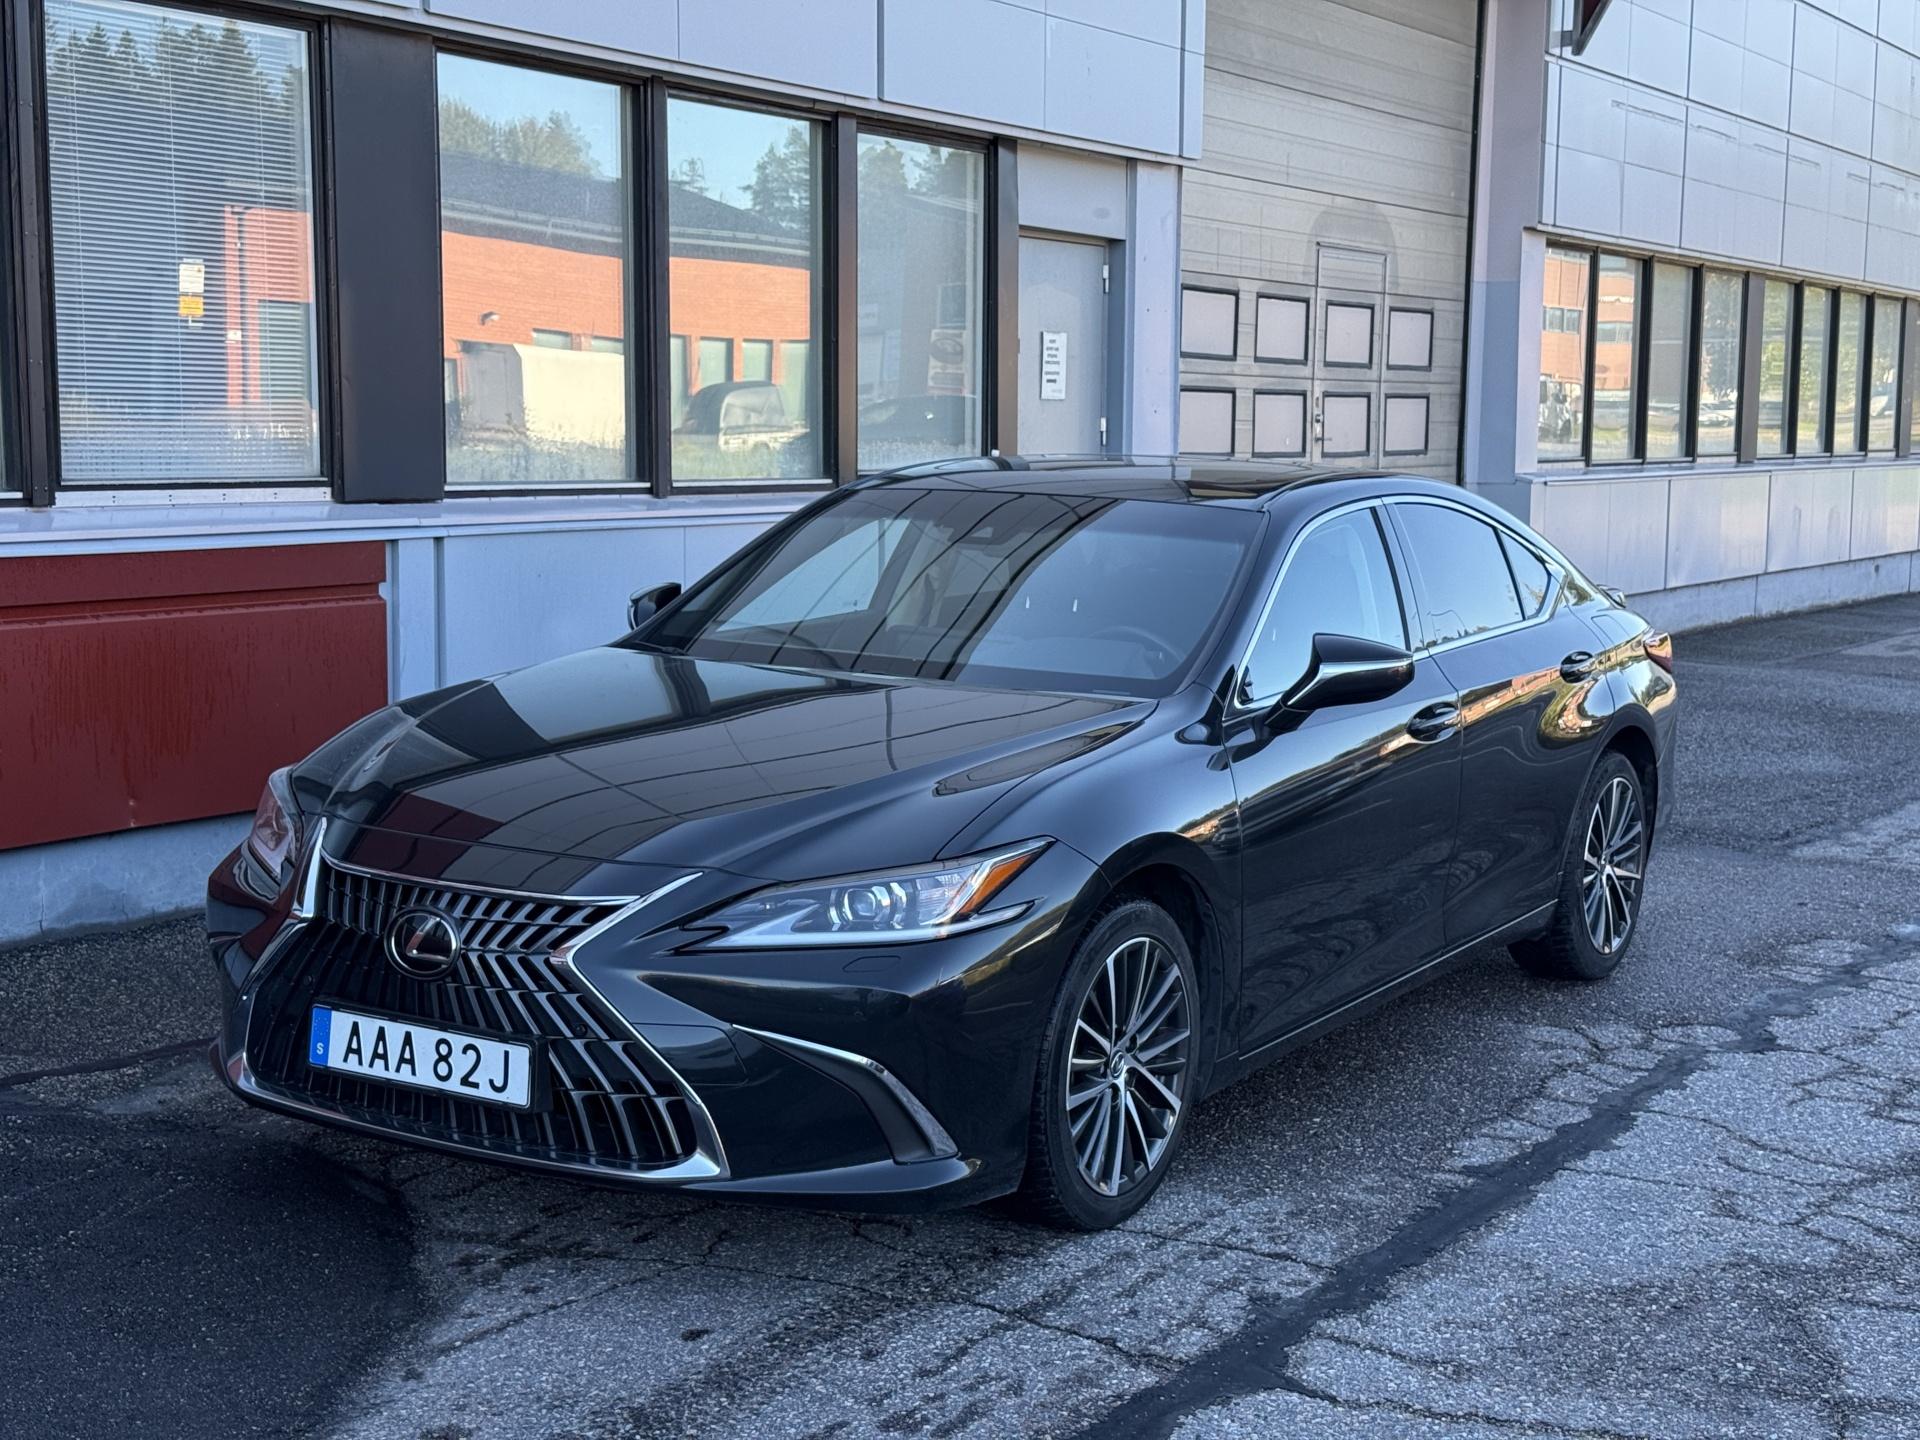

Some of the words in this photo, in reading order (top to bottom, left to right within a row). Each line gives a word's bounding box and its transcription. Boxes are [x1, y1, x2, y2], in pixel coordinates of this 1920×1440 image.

[316, 1042, 324, 1055] S
[343, 1021, 417, 1076] AAA
[432, 1038, 510, 1093] 82J
